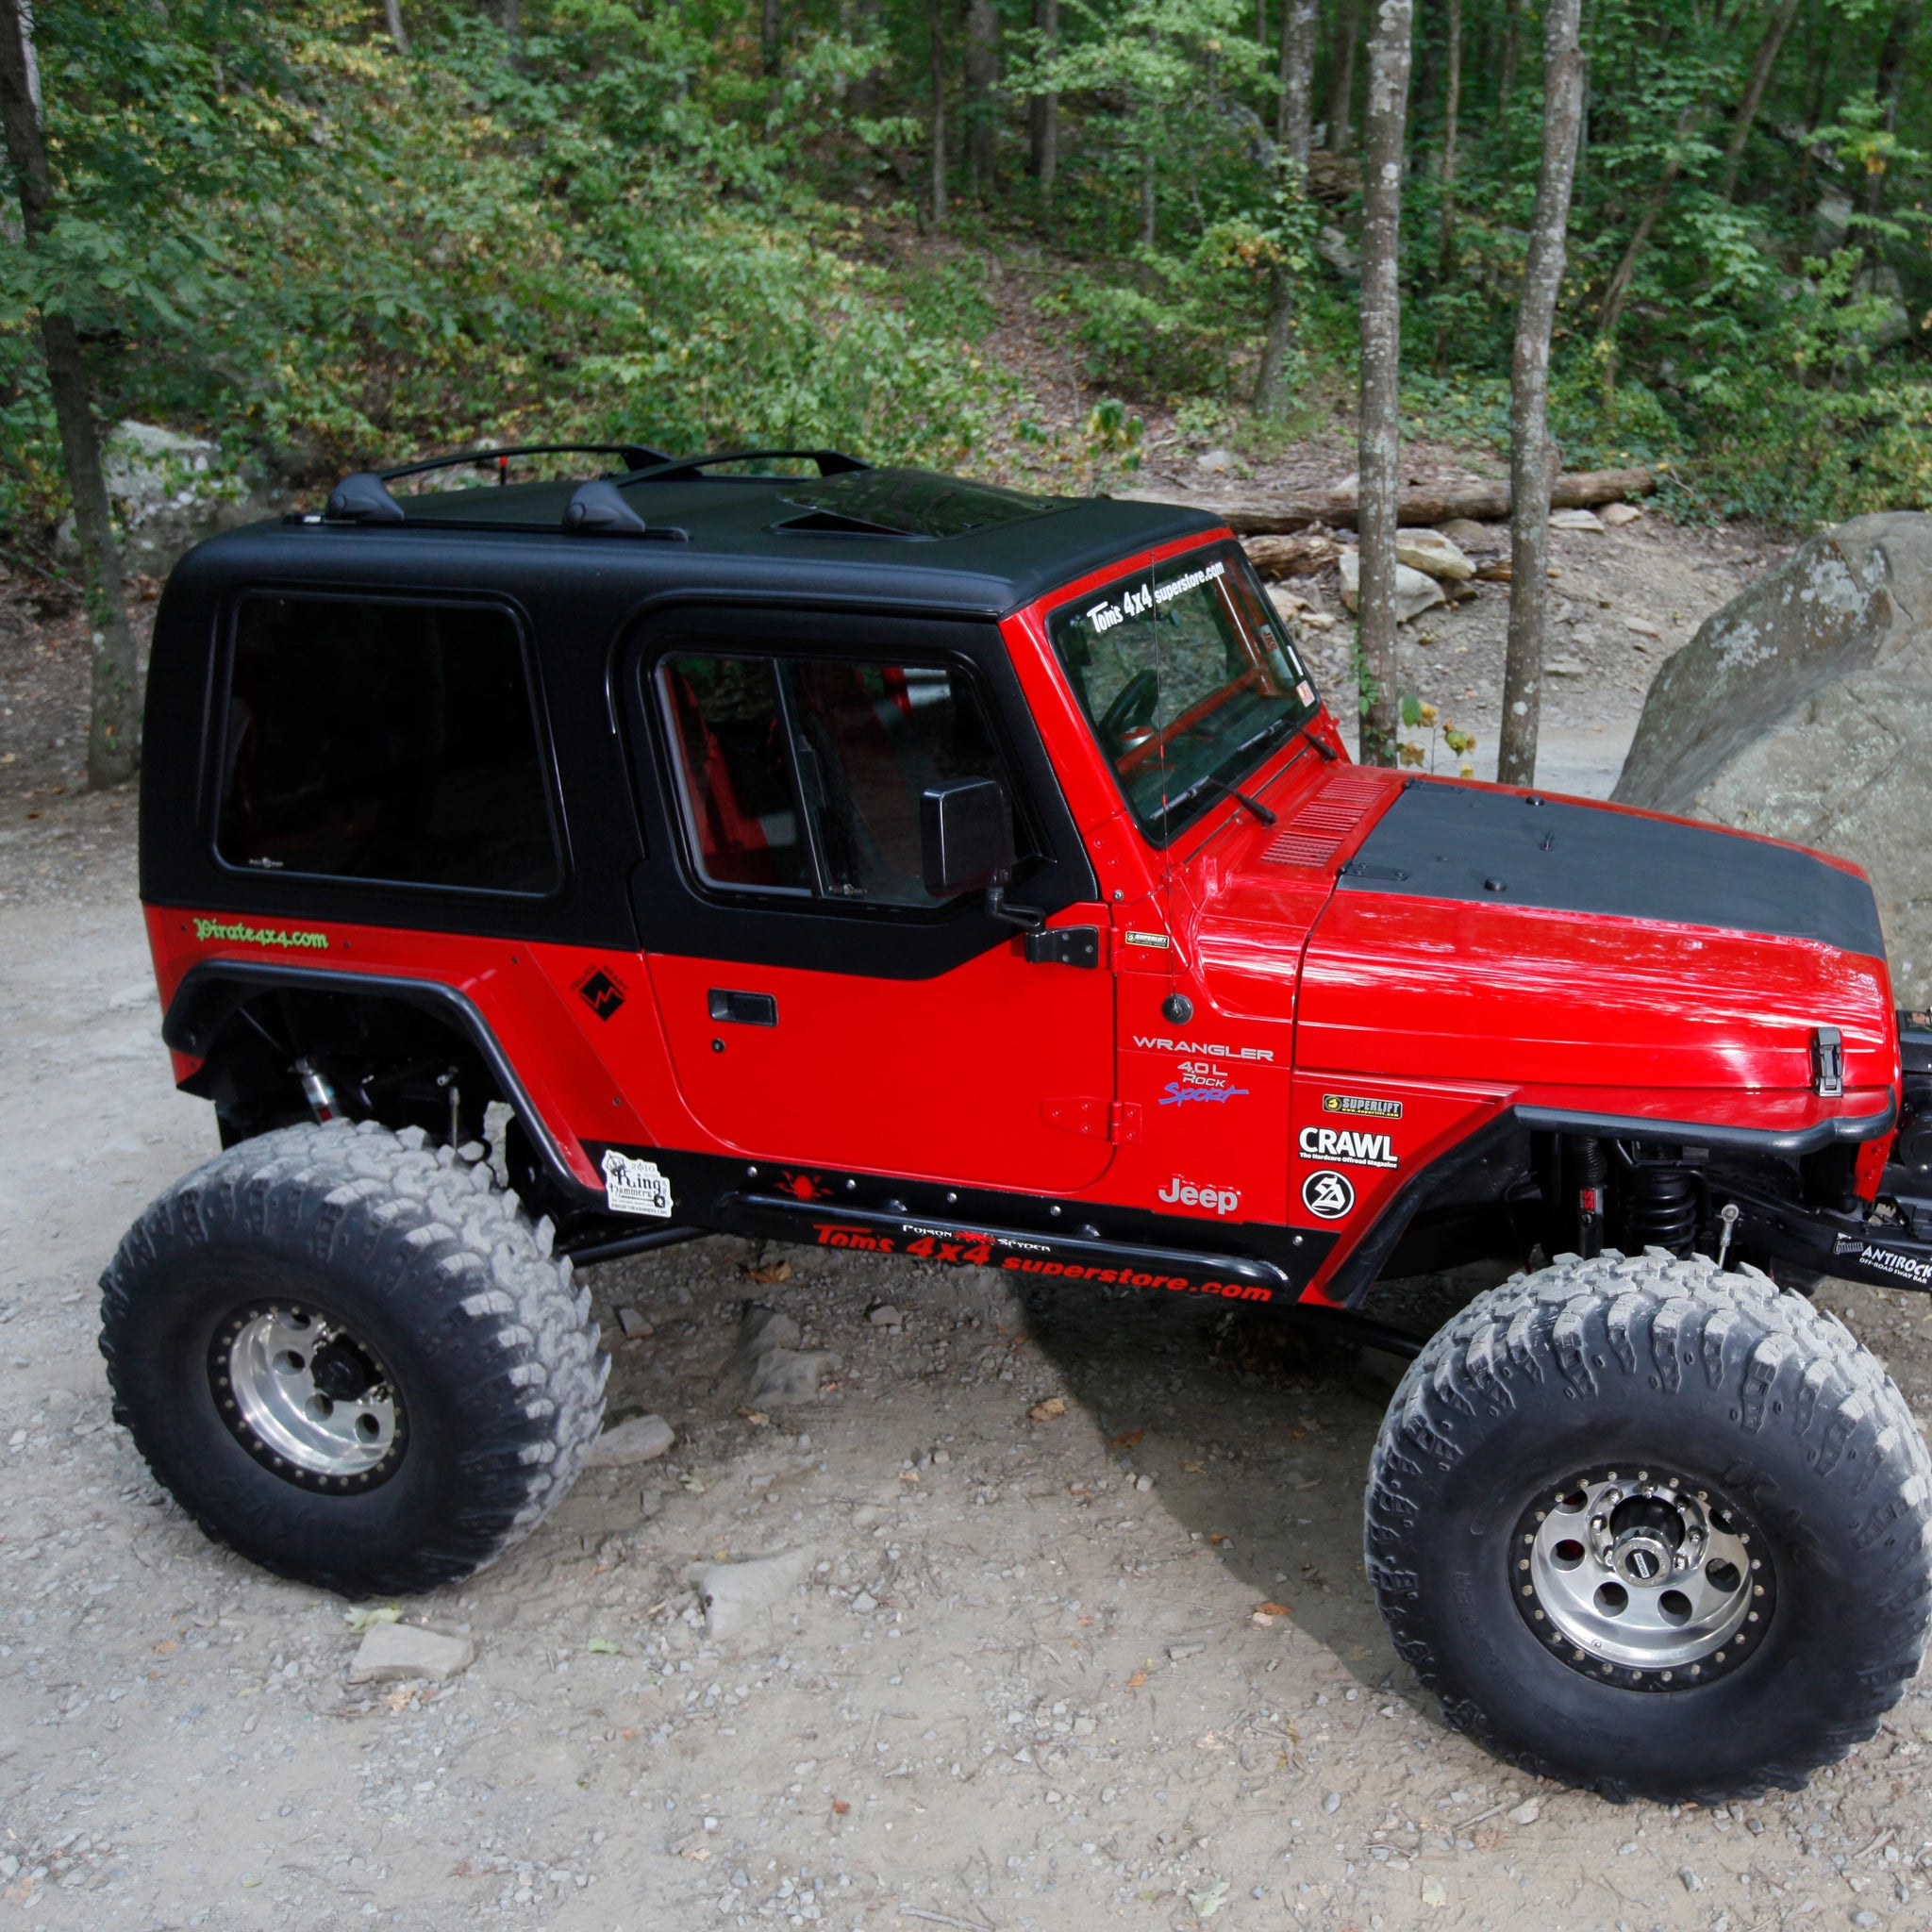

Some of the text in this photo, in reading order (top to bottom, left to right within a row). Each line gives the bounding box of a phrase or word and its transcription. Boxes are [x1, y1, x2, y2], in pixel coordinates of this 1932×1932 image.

[1086, 561, 1225, 633] Tom's 4x4 superstore.com
[193, 918, 329, 949] Pirate4x4.com
[1133, 1036, 1274, 1061] WRANGLER
[1212, 1064, 1228, 1076] L
[1341, 1098, 1400, 1113] SUPERLIFT
[1299, 1127, 1399, 1162] CRAWL
[1312, 1154, 1341, 1162] Hardcore
[1367, 1160, 1398, 1169] Magazine
[1158, 1178, 1238, 1214] Jeep
[906, 1237, 993, 1265] 4x4
[1001, 1256, 1272, 1301] superstore.com
[1859, 1257, 1928, 1285] OFF-ROAD SWAY BAR
[1861, 1245, 1932, 1278] ANTIROCK
